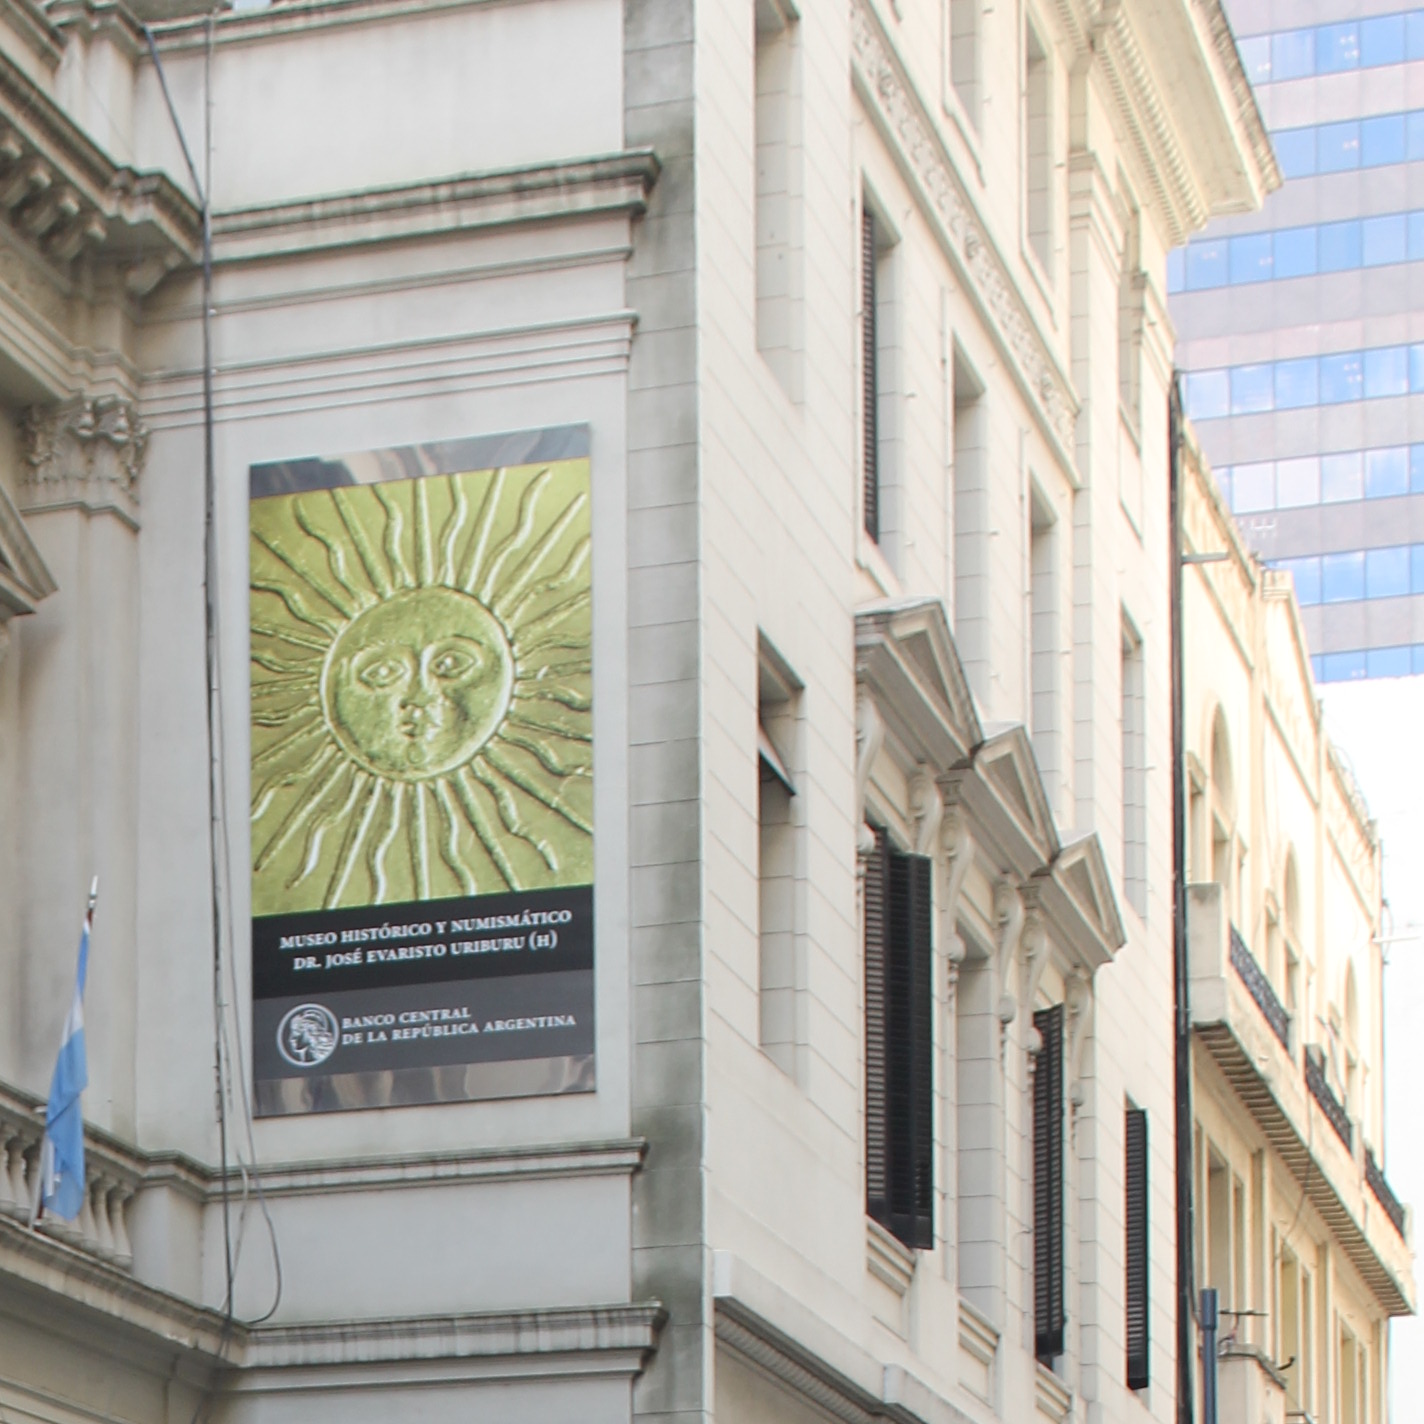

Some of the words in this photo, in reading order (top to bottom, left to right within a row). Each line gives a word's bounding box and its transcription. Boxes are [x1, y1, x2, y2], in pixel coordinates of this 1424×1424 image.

[279, 931, 337, 949] MUSEO
[340, 922, 432, 943] HISTÓRICO
[436, 921, 447, 934] Y
[451, 909, 572, 932] NUMISMÁTICO
[293, 956, 322, 970] DR.
[325, 947, 363, 969] JOSÉ
[366, 944, 447, 962] EVARISTO
[450, 936, 525, 955] URIBURU
[342, 1014, 395, 1029] BANCO
[398, 1007, 471, 1023] CENTRAL
[342, 1032, 363, 1045] DE
[367, 1031, 387, 1042] LA
[392, 1022, 479, 1040] REPÚBLICA
[483, 1014, 577, 1032] ARGENTINA
